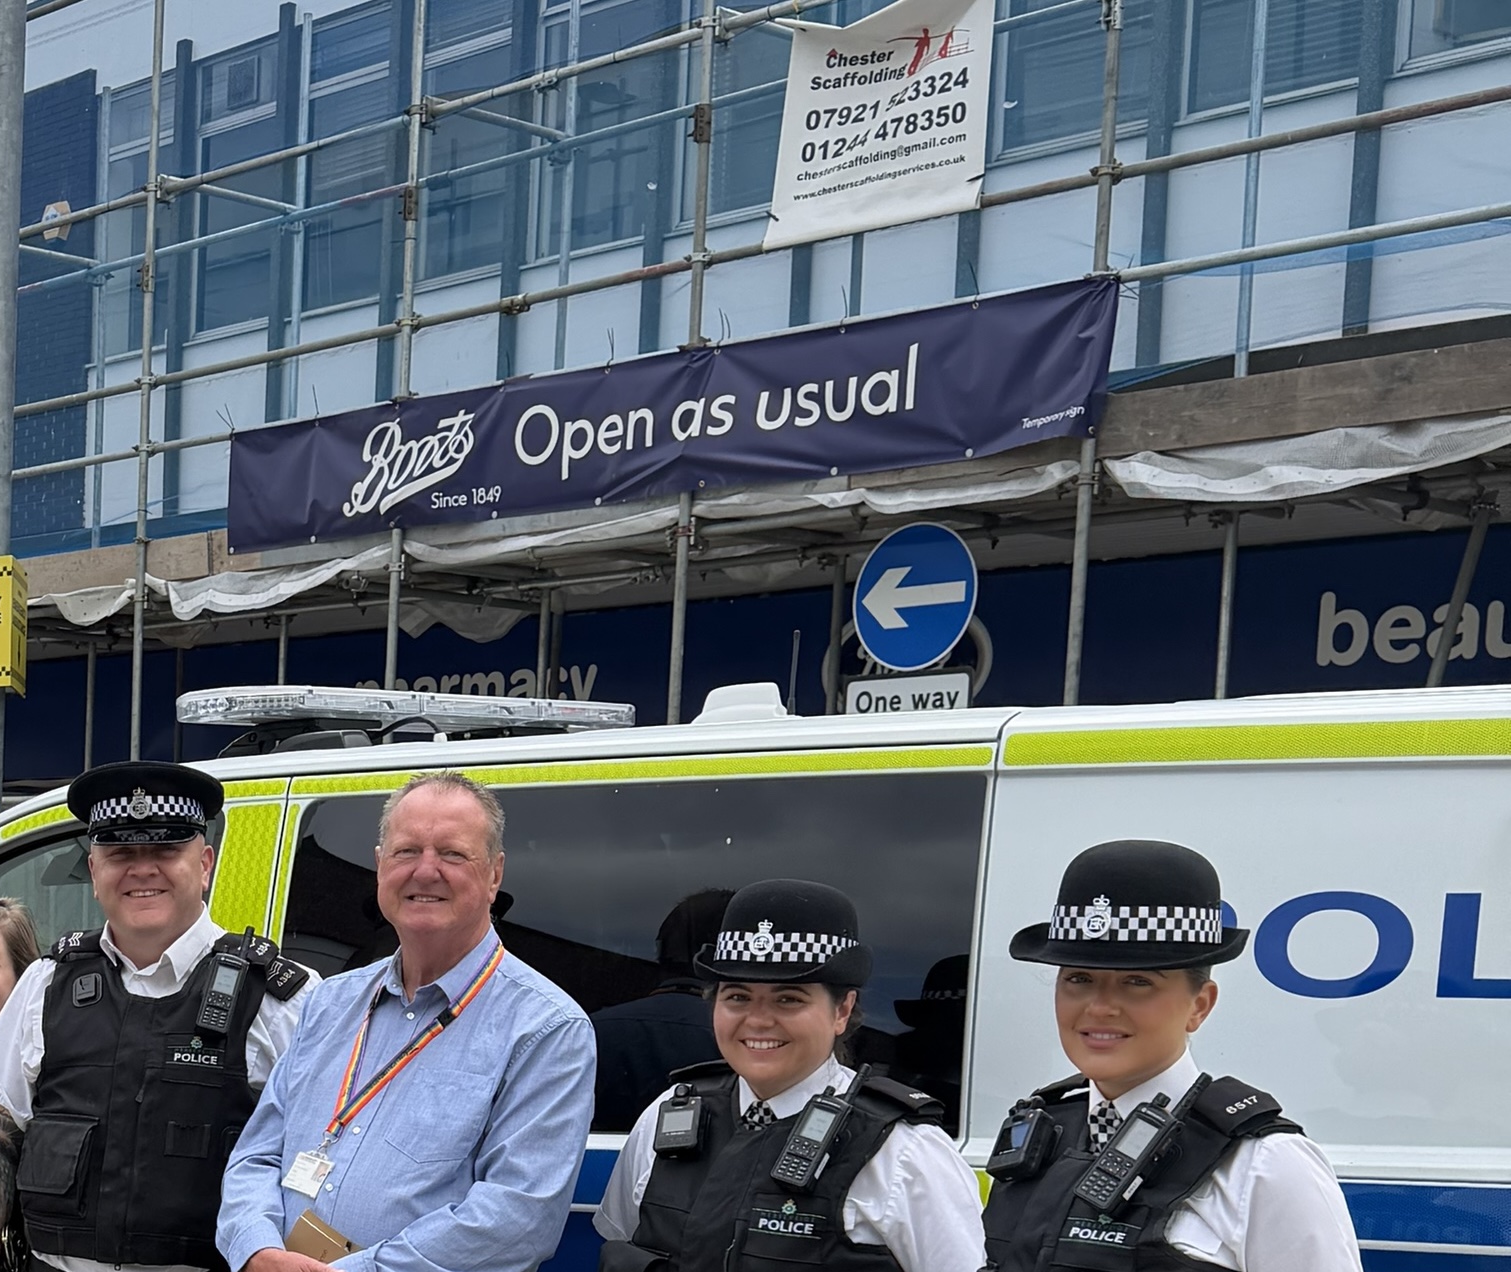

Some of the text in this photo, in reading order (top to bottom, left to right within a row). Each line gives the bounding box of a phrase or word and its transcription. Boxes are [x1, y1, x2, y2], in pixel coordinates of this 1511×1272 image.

[826, 49, 894, 68] Chester
[810, 63, 907, 90] Scaffolding
[805, 67, 969, 131] 07921 523324
[801, 102, 966, 162] 01244 478350
[796, 133, 966, 181] chesterscaffolding@gmail.com
[793, 154, 966, 201] www.chesterscaffoldingservices.co.uk
[514, 343, 919, 481] Open as usual
[343, 408, 476, 518] Boots
[431, 485, 501, 510] Since 1849
[856, 690, 960, 714] One way
[1221, 891, 1511, 999] OL
[174, 1053, 218, 1066] POLICE
[1225, 1095, 1258, 1116] 6517
[758, 1218, 814, 1235] POLICE
[1069, 1227, 1126, 1244] POLICE
